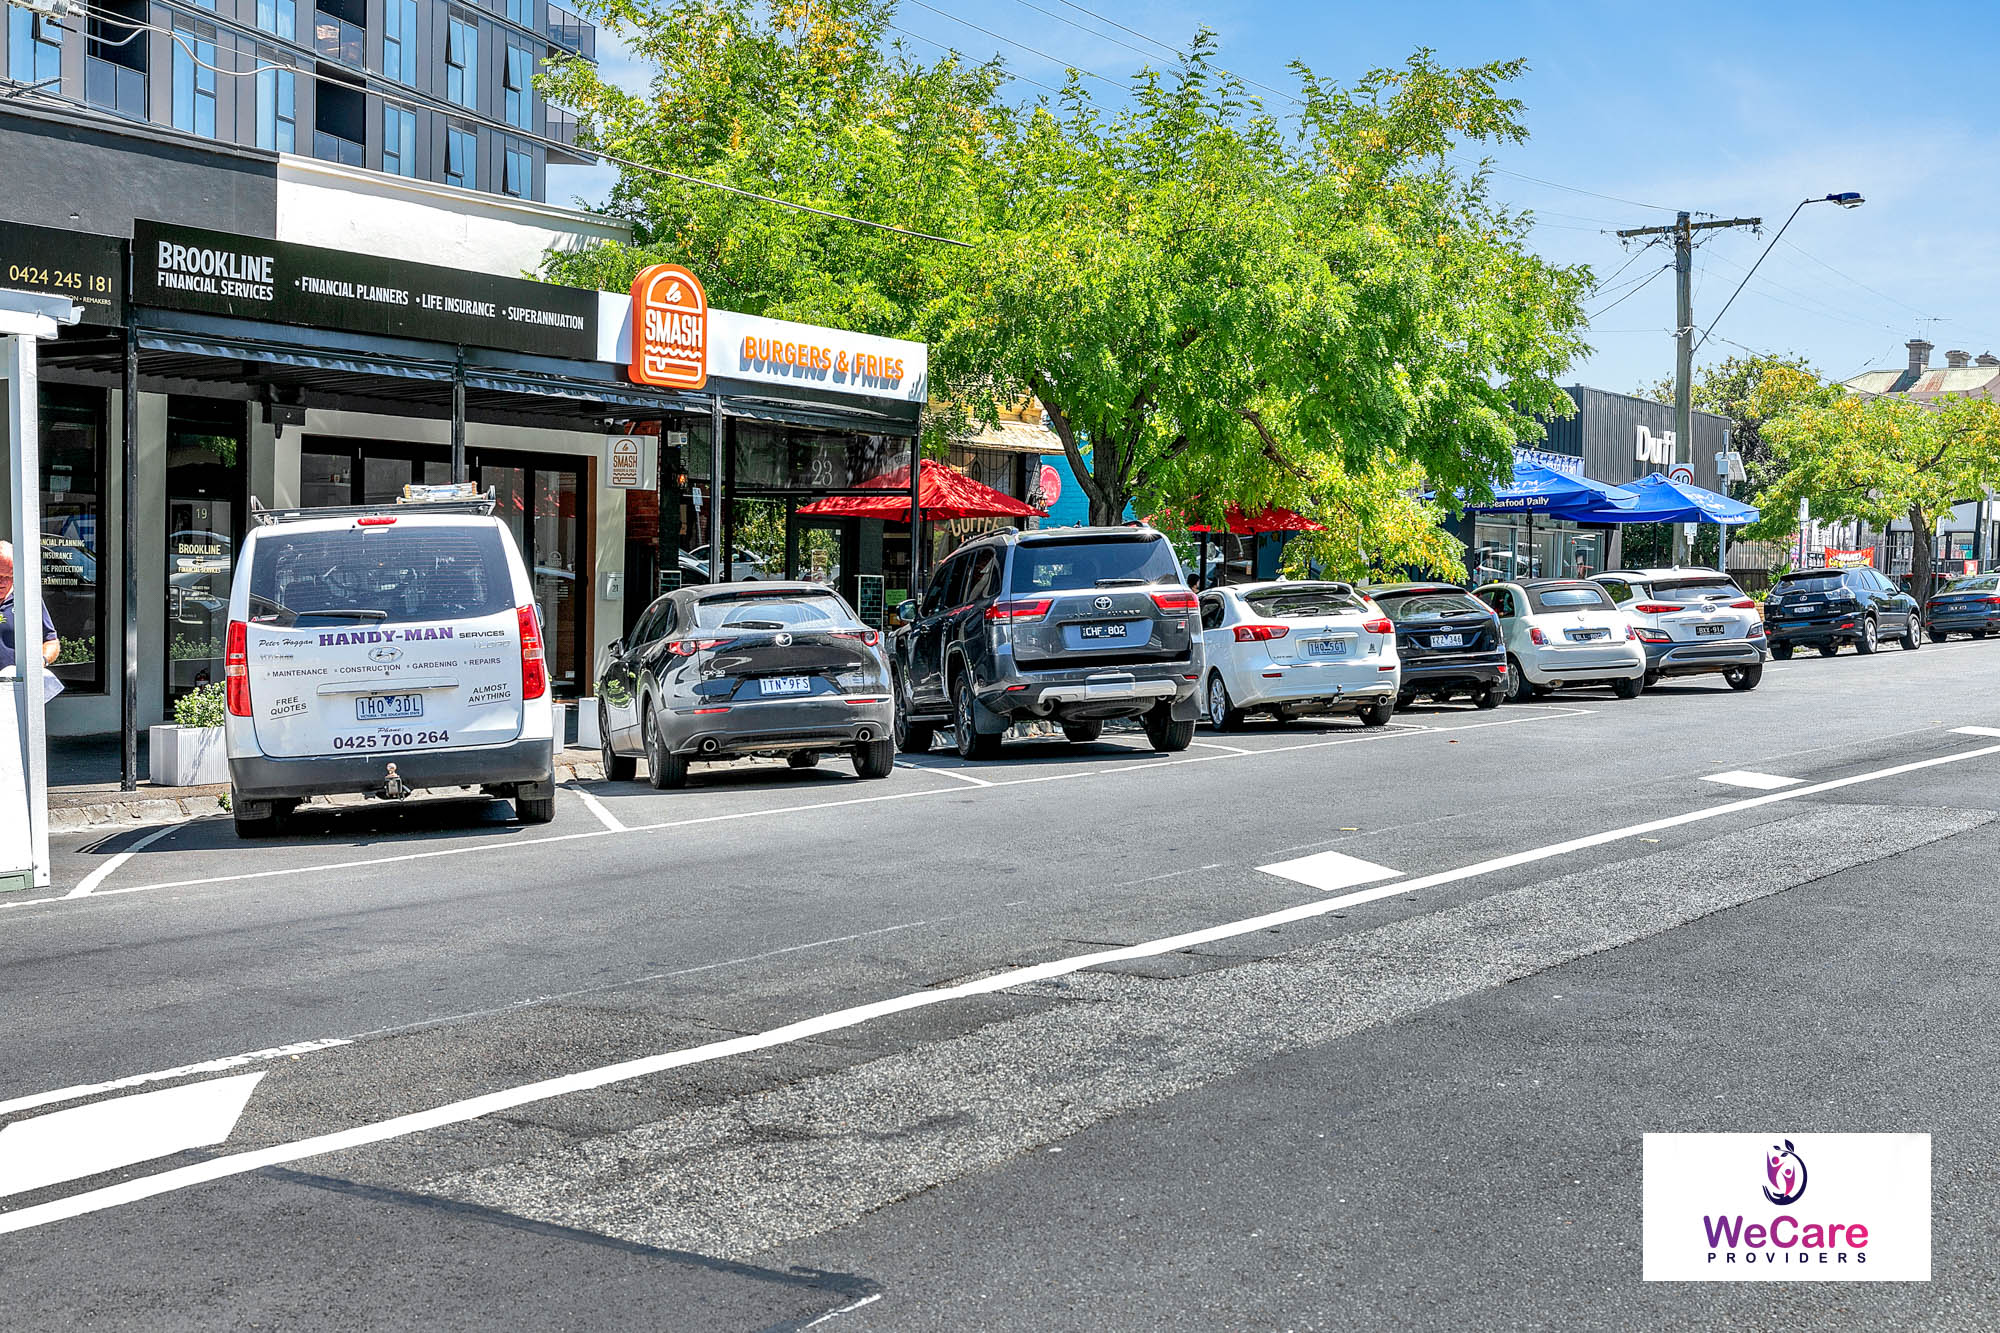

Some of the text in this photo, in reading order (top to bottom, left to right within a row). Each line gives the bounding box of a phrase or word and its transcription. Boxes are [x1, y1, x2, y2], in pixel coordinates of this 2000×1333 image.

[158, 240, 275, 284] BROOKLINE
[9, 265, 112, 293] 0424 245 181
[157, 271, 274, 301] FINANCIAL SERVICES
[301, 276, 584, 330] FINANCIAL PLANNERS LIFE INSURANCE SUPERANNUATION
[645, 309, 703, 348] SMASH
[744, 335, 904, 380] BURGERS & FRIES
[613, 455, 638, 468] SMASH
[812, 459, 833, 487] 23
[1526, 496, 1549, 506] Daily
[196, 508, 208, 519] 19
[42, 551, 73, 560] INSURANCE
[178, 543, 221, 555] BROOKLINE
[50, 565, 84, 573] PROTECTION
[258, 626, 505, 648] Peter Hoggan HANDY-MAN SERVICES
[272, 657, 501, 677] MAINTENANCE CONSTRUCTION GARDENING REPAIRS
[473, 682, 507, 695] ALMOST
[276, 695, 299, 706] FREE
[395, 697, 420, 712] 3DL
[468, 691, 511, 703] ANYTHING
[270, 702, 307, 716] QUOTES
[333, 730, 449, 749] 0425 700 264
